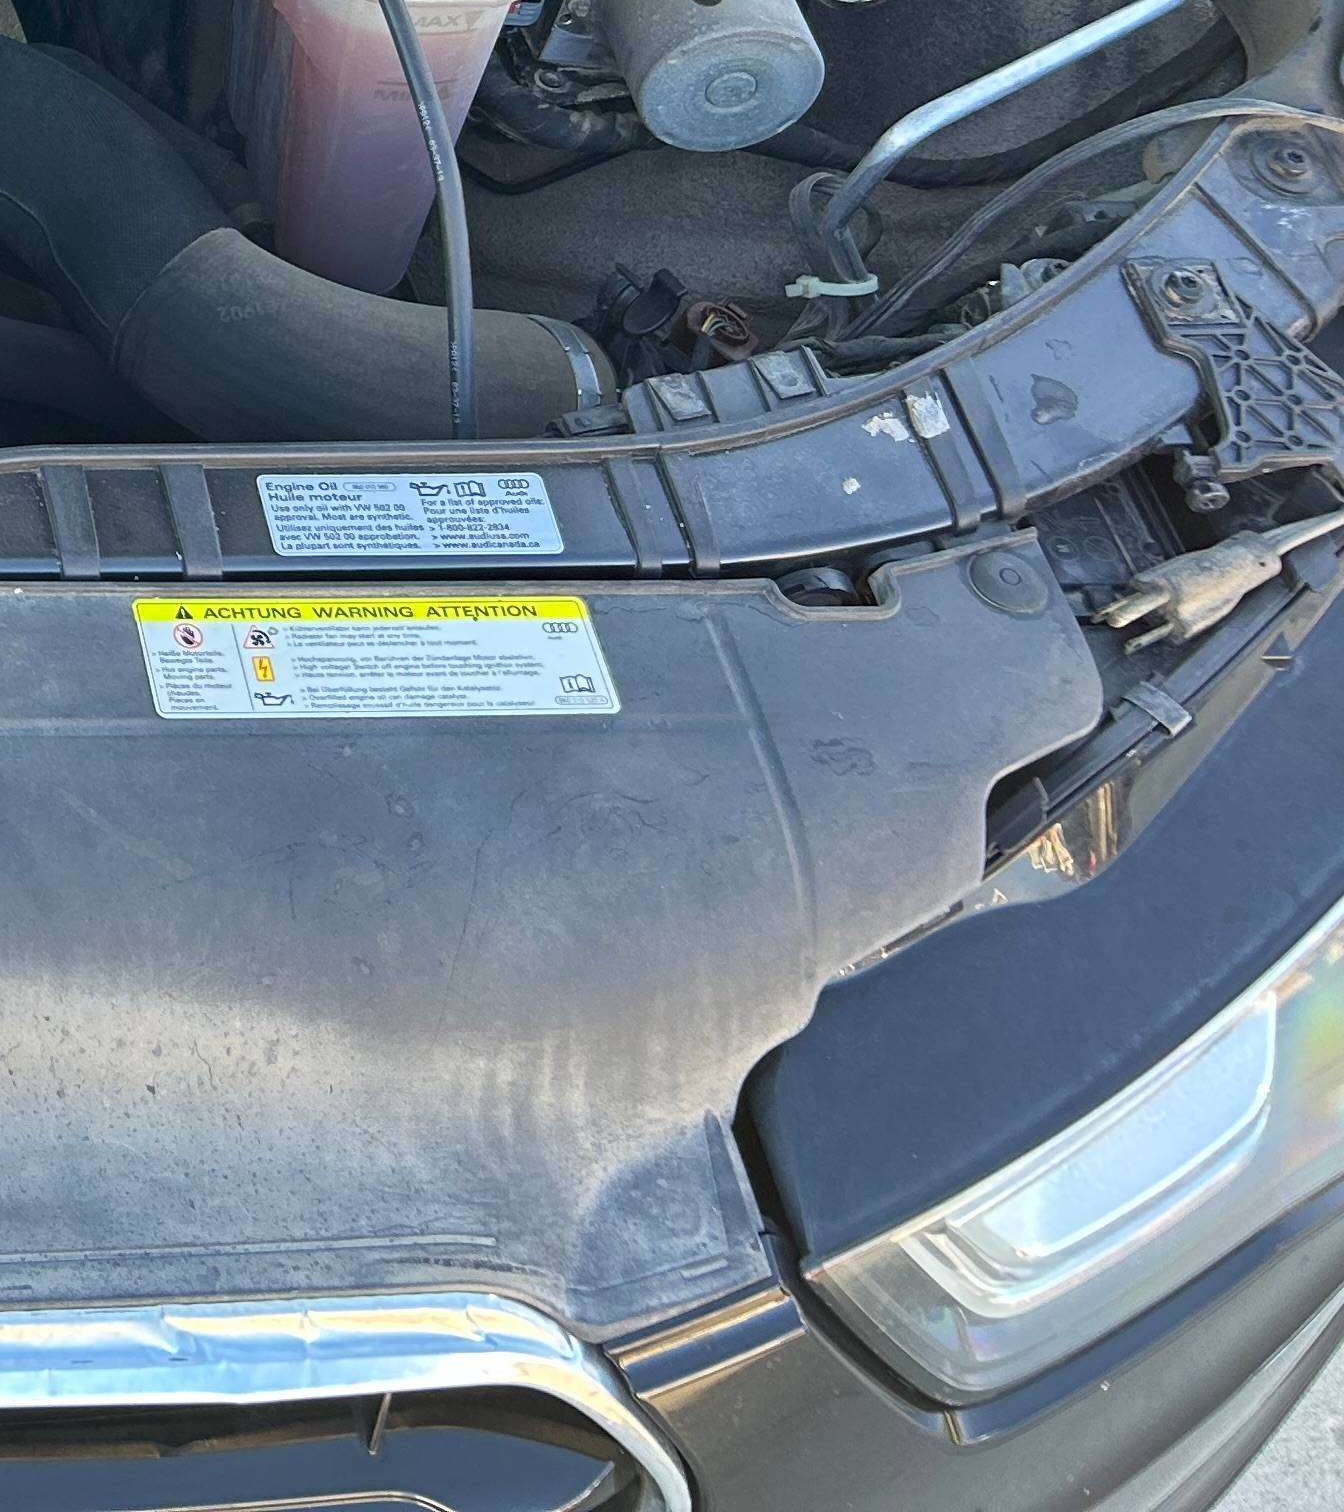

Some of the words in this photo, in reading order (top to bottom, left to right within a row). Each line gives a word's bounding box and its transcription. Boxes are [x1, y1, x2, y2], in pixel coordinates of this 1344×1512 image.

[265, 482, 314, 492] Engine
[318, 481, 338, 491] Oil
[268, 492, 304, 502] Huile
[309, 494, 362, 502] moteur
[465, 498, 475, 506] of
[478, 498, 523, 507] approved
[293, 504, 314, 514] only
[316, 504, 329, 512] oil
[331, 504, 352, 512] with
[355, 504, 371, 512] VW
[423, 507, 446, 515] Pour
[470, 507, 490, 515] liste
[322, 513, 347, 521] Most
[367, 513, 414, 523] synthetic.
[276, 524, 312, 532] Utilisez
[314, 524, 372, 533] uniquement
[375, 524, 393, 532] des
[395, 524, 424, 532] huiles
[304, 533, 321, 541] VW
[440, 532, 530, 540] www.audiusa.com
[280, 542, 293, 550] La
[295, 542, 330, 551] plupart
[443, 541, 541, 550] www.audicanada.ca
[203, 607, 302, 619] ACHTUNG
[311, 606, 414, 618] WARNING
[426, 605, 538, 618] ATTENTION
